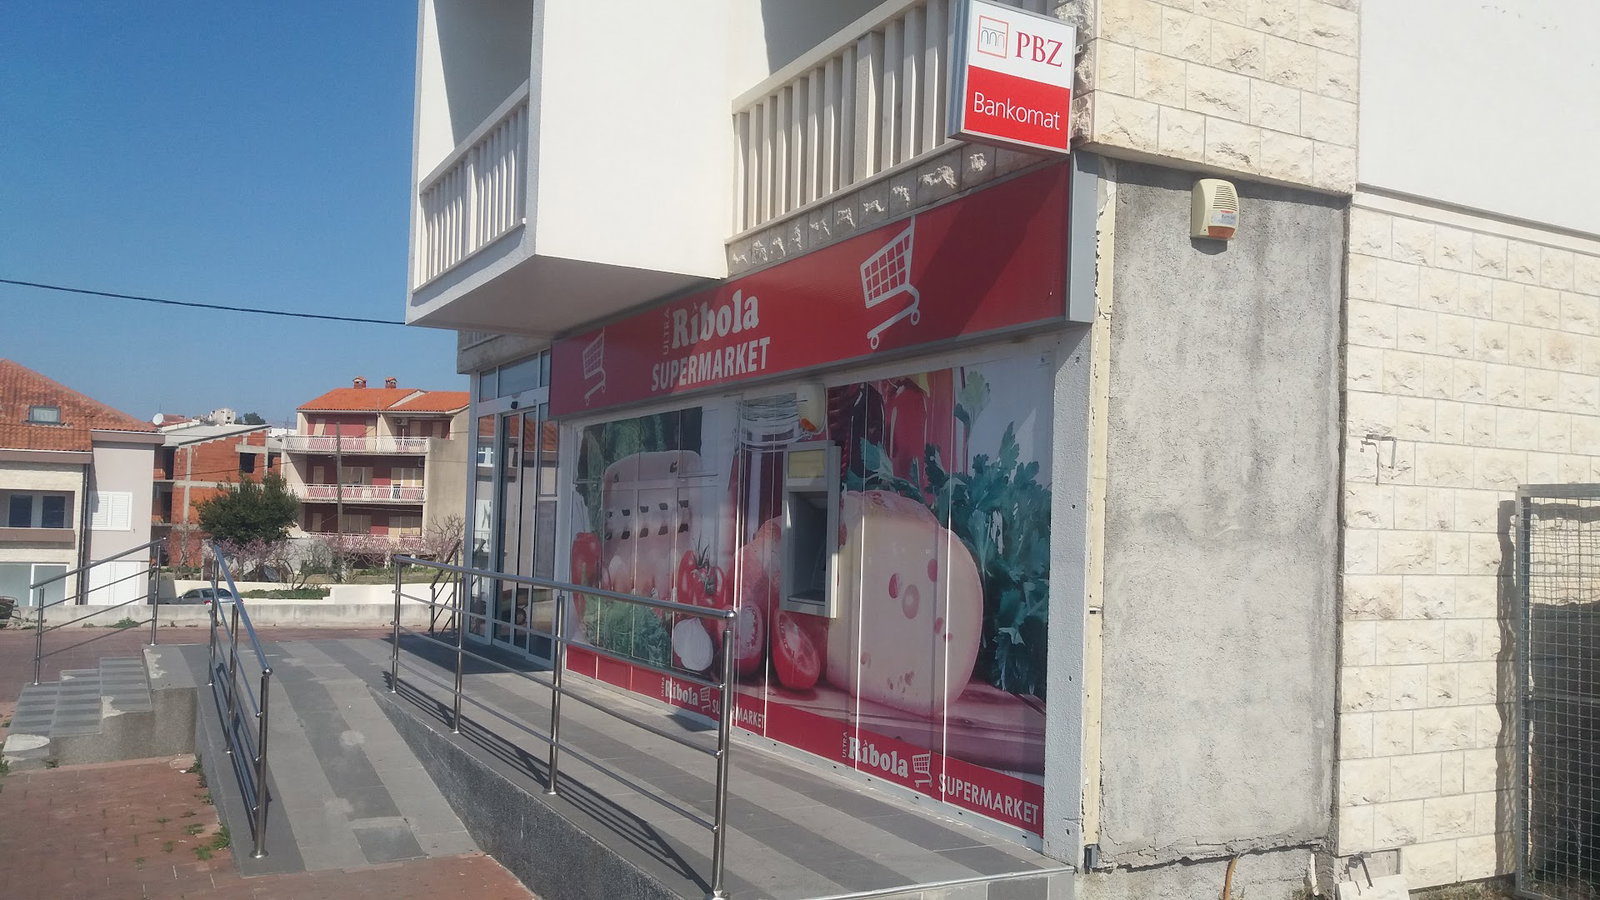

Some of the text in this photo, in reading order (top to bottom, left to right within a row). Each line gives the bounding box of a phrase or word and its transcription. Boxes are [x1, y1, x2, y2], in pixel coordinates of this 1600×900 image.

[1015, 31, 1063, 67] PBZ
[973, 91, 1060, 130] Bankomat
[651, 336, 771, 392] SUPERMARKET
[711, 699, 766, 729] SURMARKET
[938, 773, 1039, 825] SUPERMARKET
